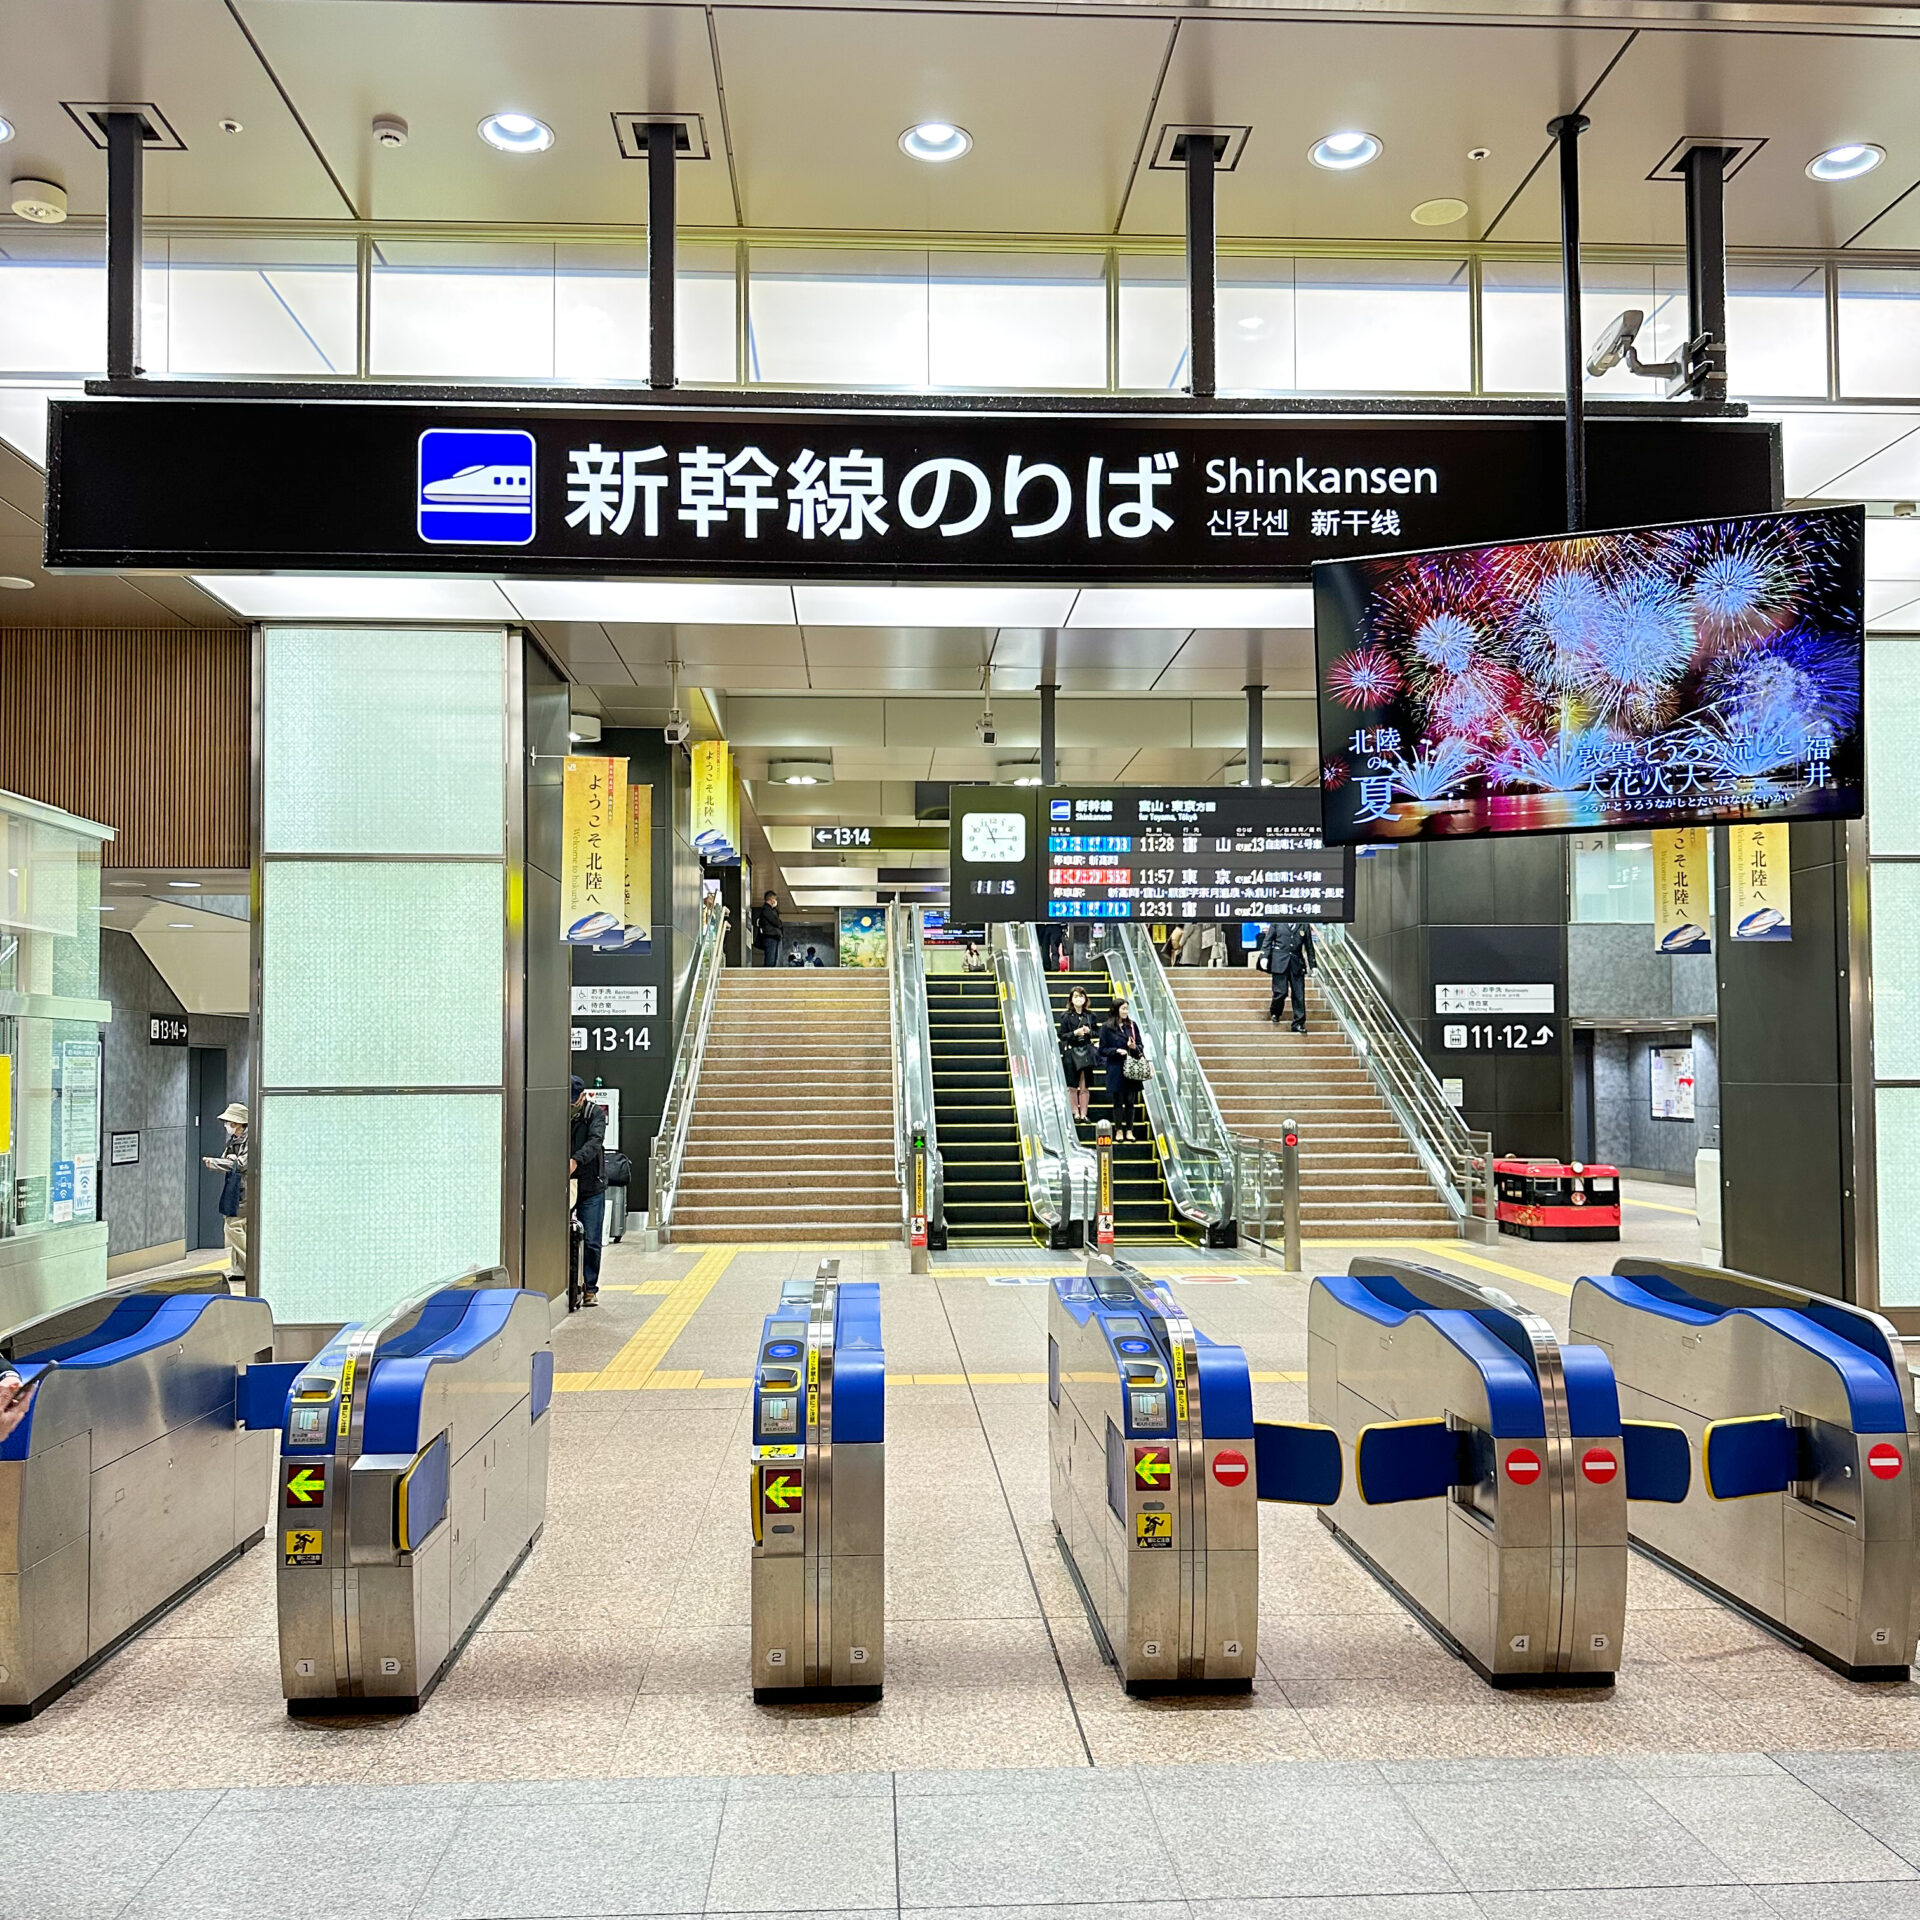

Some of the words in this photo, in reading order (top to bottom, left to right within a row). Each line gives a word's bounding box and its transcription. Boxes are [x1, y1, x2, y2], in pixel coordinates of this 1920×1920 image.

[1206, 457, 1438, 494] Shinkansen
[565, 444, 1179, 540] 新幹線のりば
[1206, 508, 1289, 536] 신칸센
[1310, 508, 1401, 537] 新干线
[1348, 727, 1401, 754] 北陸
[1367, 756, 1383, 770] の
[1803, 735, 1833, 788] 福井
[1579, 761, 1740, 801] 大花火大会
[1351, 774, 1402, 824] 夏
[586, 774, 602, 905] ようこそ北陸へ
[1140, 837, 1174, 851] 11:28
[1751, 830, 1767, 902] そ北陸へ
[1140, 869, 1174, 884] 11:57
[1001, 880, 1015, 894] 15
[1140, 901, 1174, 916] 12:31
[592, 1027, 651, 1051] 13・14
[1471, 1025, 1528, 1049] 11・12
[1515, 1639, 1525, 1648] 4
[1594, 1637, 1604, 1647] 5
[1876, 1631, 1886, 1641] 5
[854, 1650, 864, 1660] 3
[1147, 1644, 1157, 1654] 3
[1227, 1643, 1237, 1653] 4
[772, 1652, 782, 1662] 2
[303, 1663, 309, 1672] 1
[385, 1661, 395, 1671] 2
